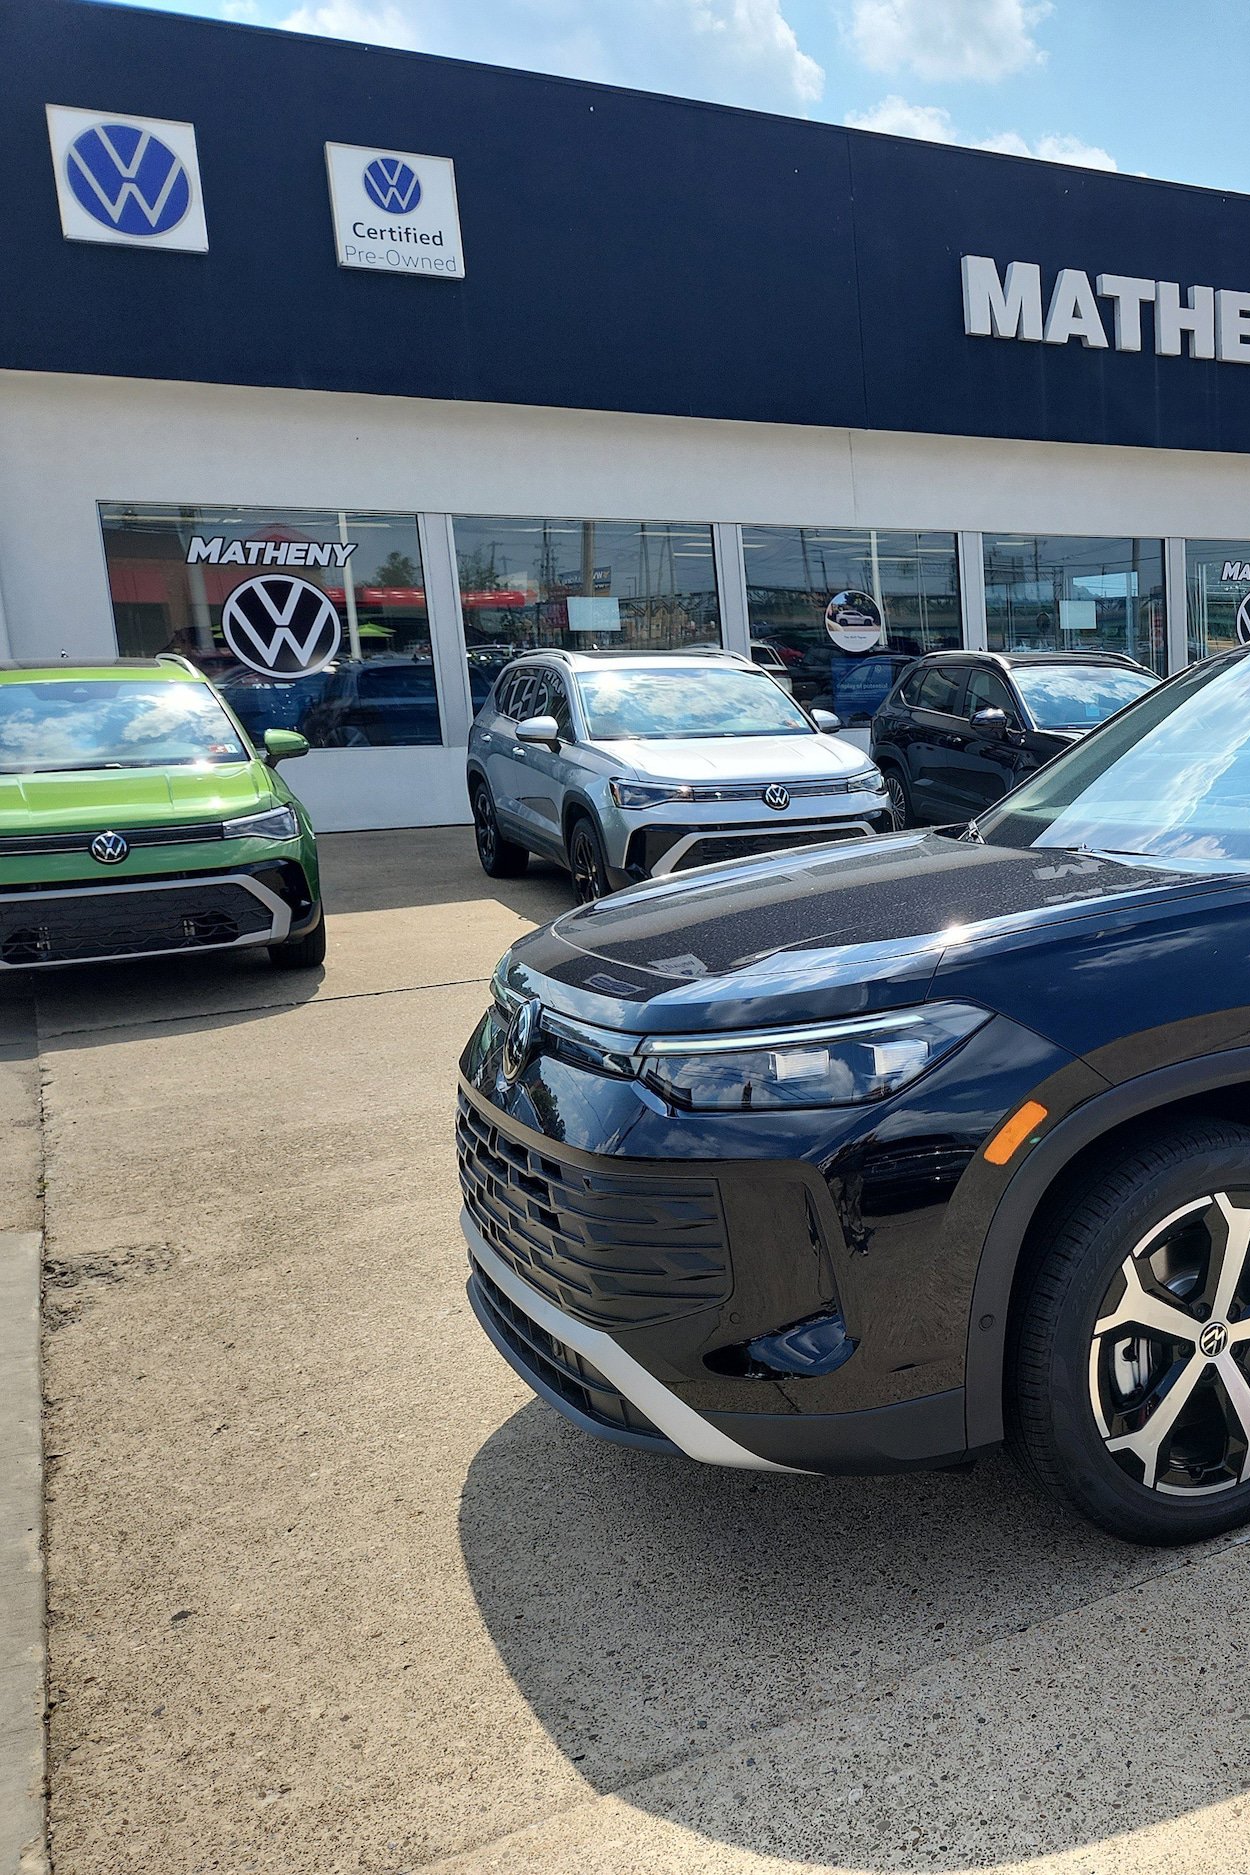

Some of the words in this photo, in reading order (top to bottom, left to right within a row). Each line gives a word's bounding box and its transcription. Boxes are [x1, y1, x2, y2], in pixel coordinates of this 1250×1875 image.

[352, 221, 444, 248] Certified
[344, 245, 458, 273] Pre-Owned
[186, 536, 358, 567] MATHENY
